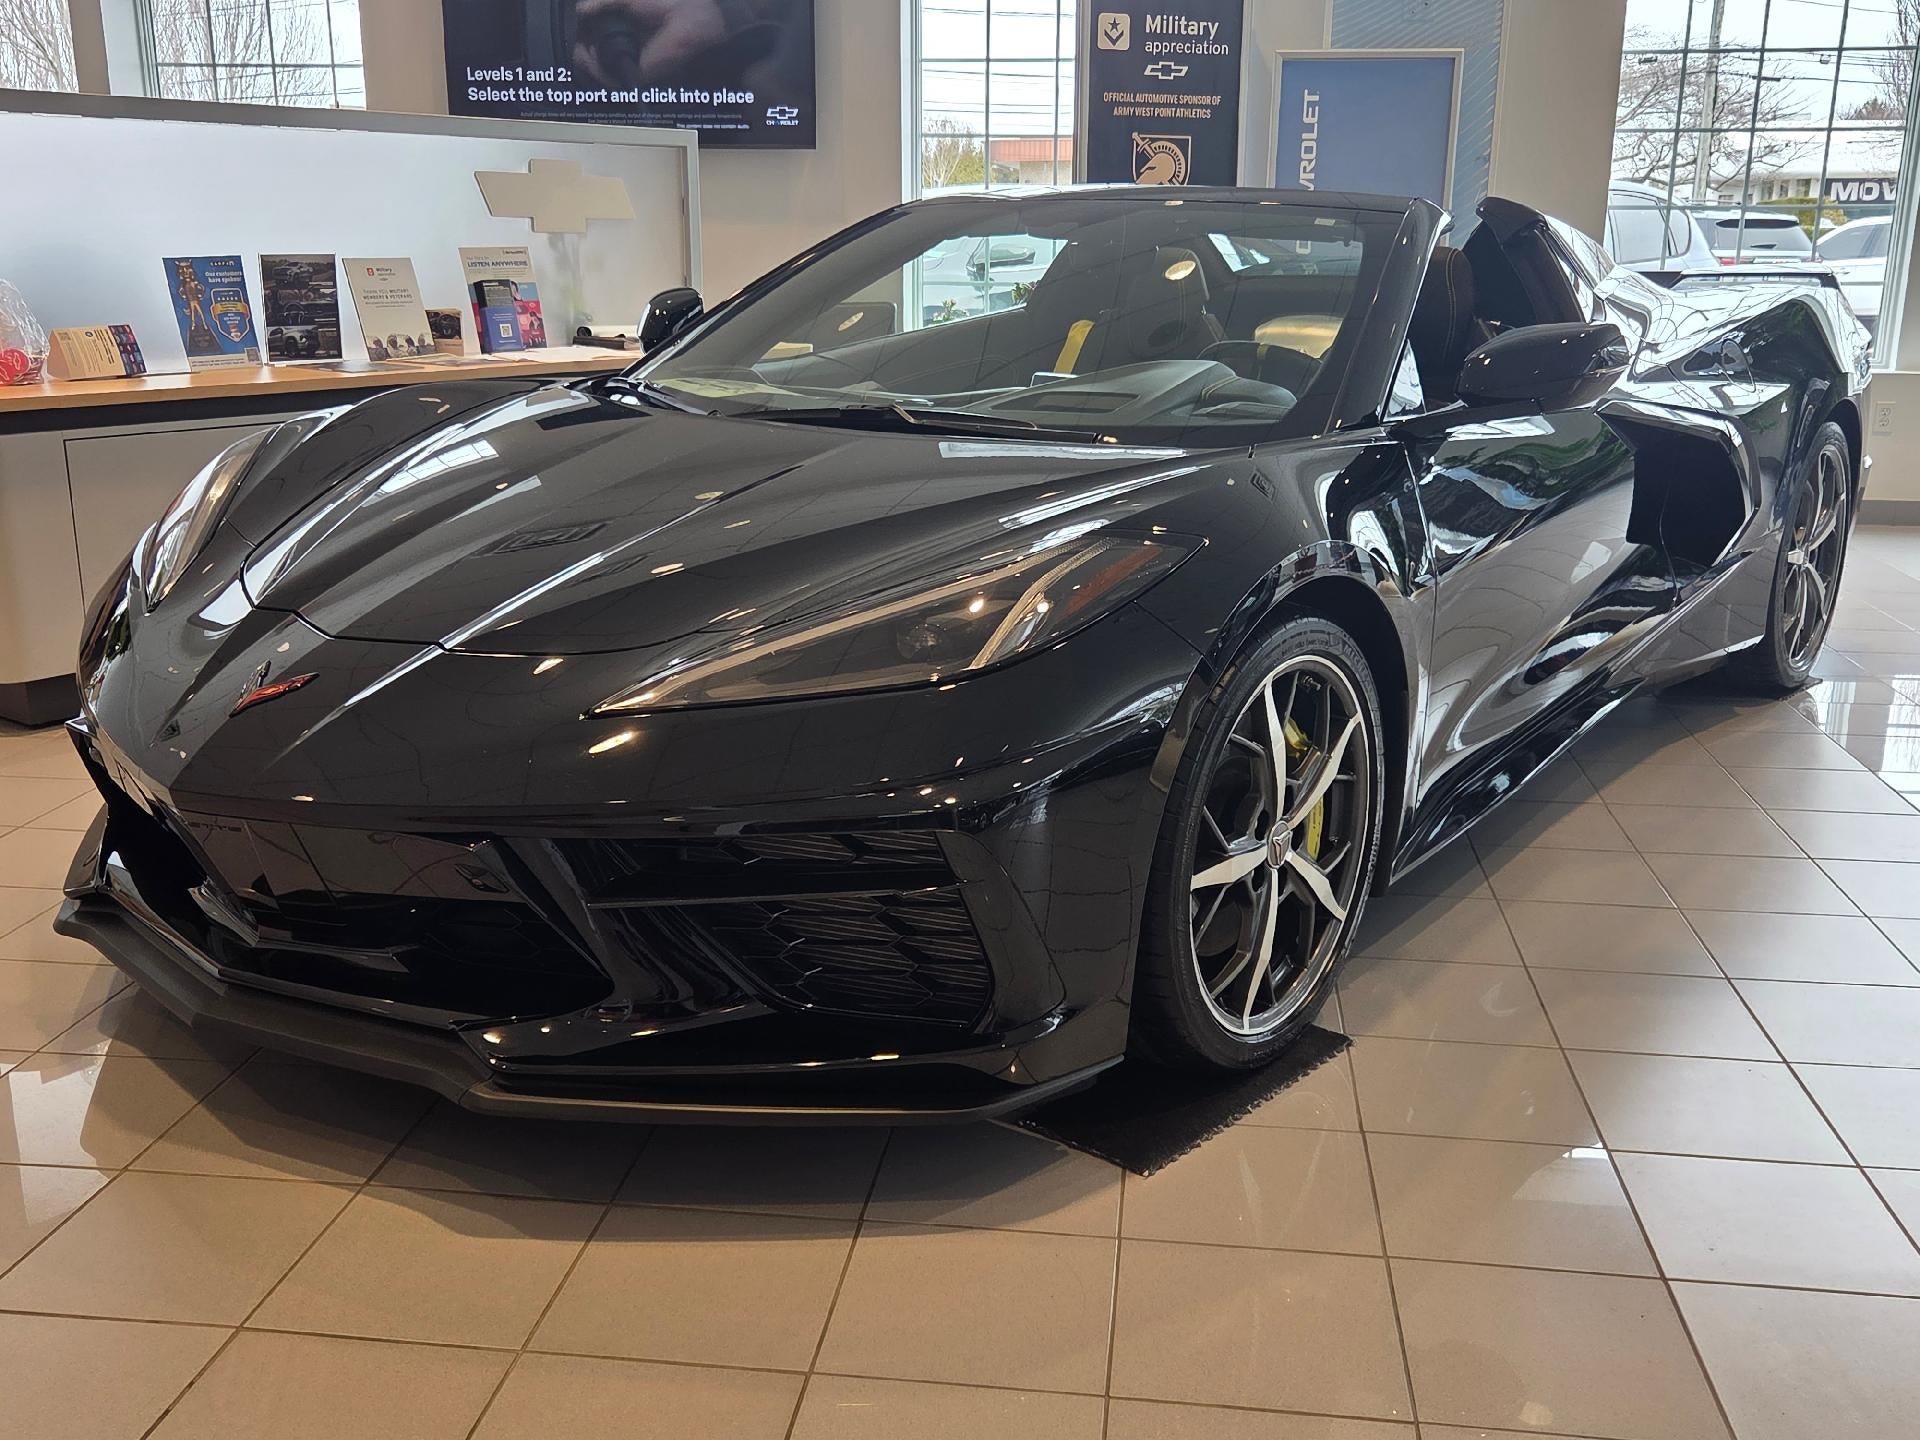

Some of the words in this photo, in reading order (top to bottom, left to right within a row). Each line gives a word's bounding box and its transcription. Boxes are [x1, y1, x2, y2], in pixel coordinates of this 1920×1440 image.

[1145, 14, 1219, 40] Military
[1145, 40, 1229, 55] appreciation
[466, 66, 513, 81] Levels
[515, 67, 523, 81] 1
[526, 66, 554, 81] and
[557, 67, 572, 82] 2:
[467, 86, 517, 102] Select
[518, 87, 544, 102] the
[546, 88, 573, 105] top
[575, 88, 608, 105] port
[610, 88, 638, 103] and
[641, 88, 677, 104] click
[680, 88, 710, 104] into
[713, 88, 755, 106] place
[1103, 91, 1135, 103] OFFICIAL
[1135, 93, 1178, 105] AUTOMOTIVE
[1179, 95, 1211, 106] SPONSOR
[1211, 95, 1222, 107] OF
[1113, 106, 1135, 117] ARMY
[1135, 107, 1154, 117] WEST
[1154, 107, 1176, 118] POINT
[1175, 108, 1212, 119] ATHLETICS
